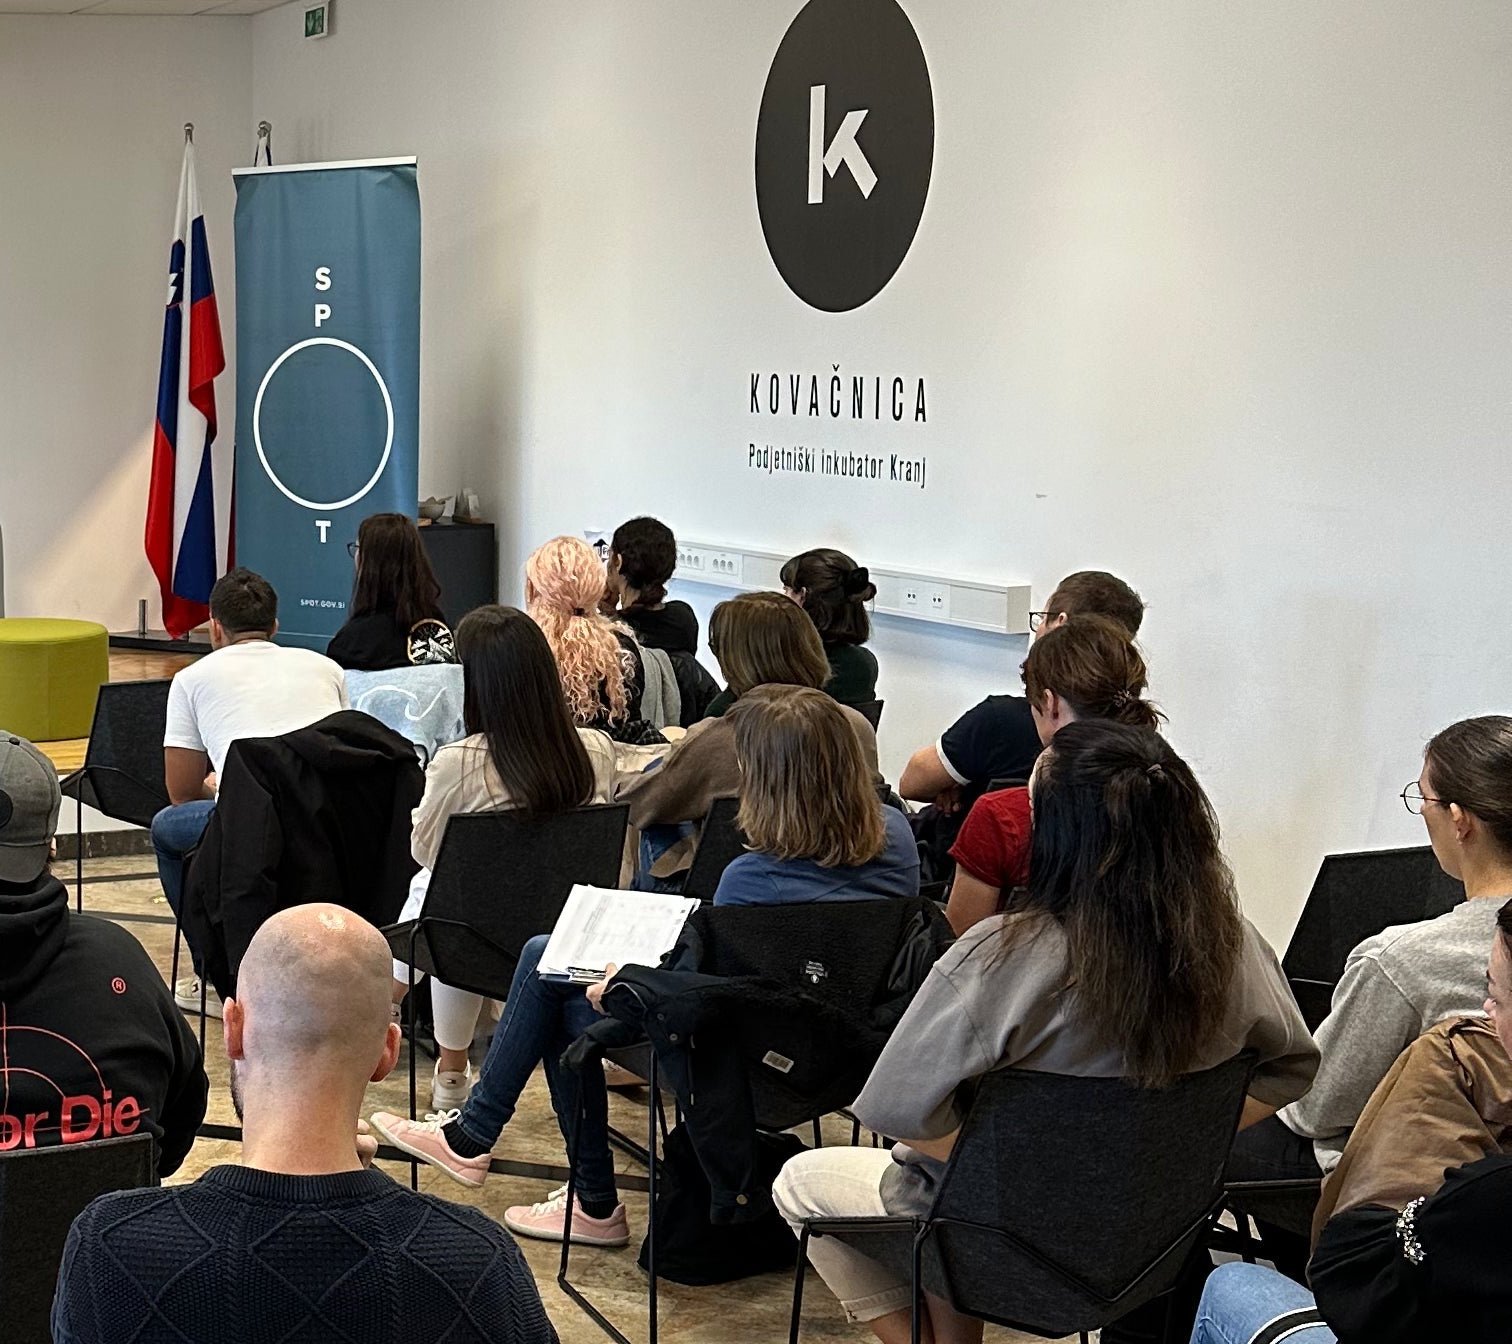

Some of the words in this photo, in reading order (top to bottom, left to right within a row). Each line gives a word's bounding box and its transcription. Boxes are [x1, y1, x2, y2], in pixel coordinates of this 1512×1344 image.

[749, 363, 927, 423] KOVAČNICA
[748, 442, 816, 475] Podjetniški
[821, 447, 884, 480] inkubator
[889, 453, 926, 489] Kranj
[60, 1088, 141, 1145] Die
